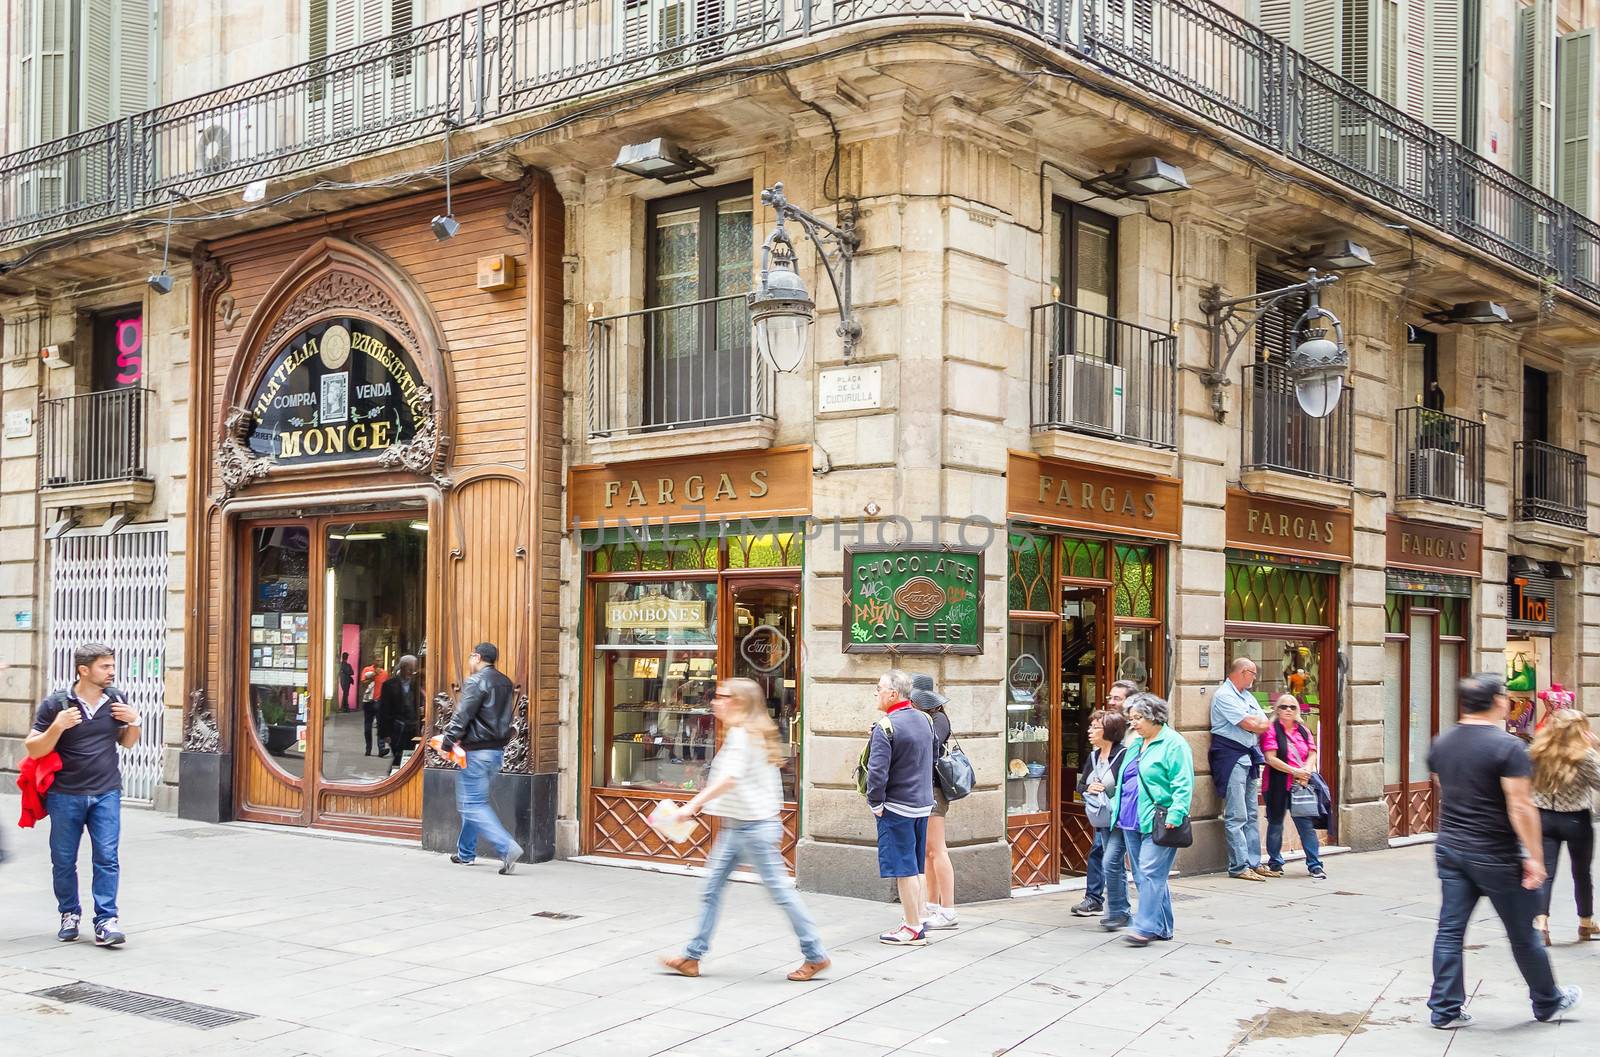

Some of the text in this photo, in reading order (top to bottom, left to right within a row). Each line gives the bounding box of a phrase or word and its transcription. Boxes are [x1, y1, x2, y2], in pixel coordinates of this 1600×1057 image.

[274, 391, 317, 409] COMPRA
[356, 381, 392, 400] VENDA
[279, 420, 392, 459] MONGE
[604, 470, 769, 509] FARGAS
[1038, 475, 1157, 519] FARGAS
[1247, 508, 1335, 544] FARGAS
[1401, 532, 1469, 561] FARGAS
[857, 556, 975, 583] CHOCOLATES
[611, 607, 701, 624] BOMBONES
